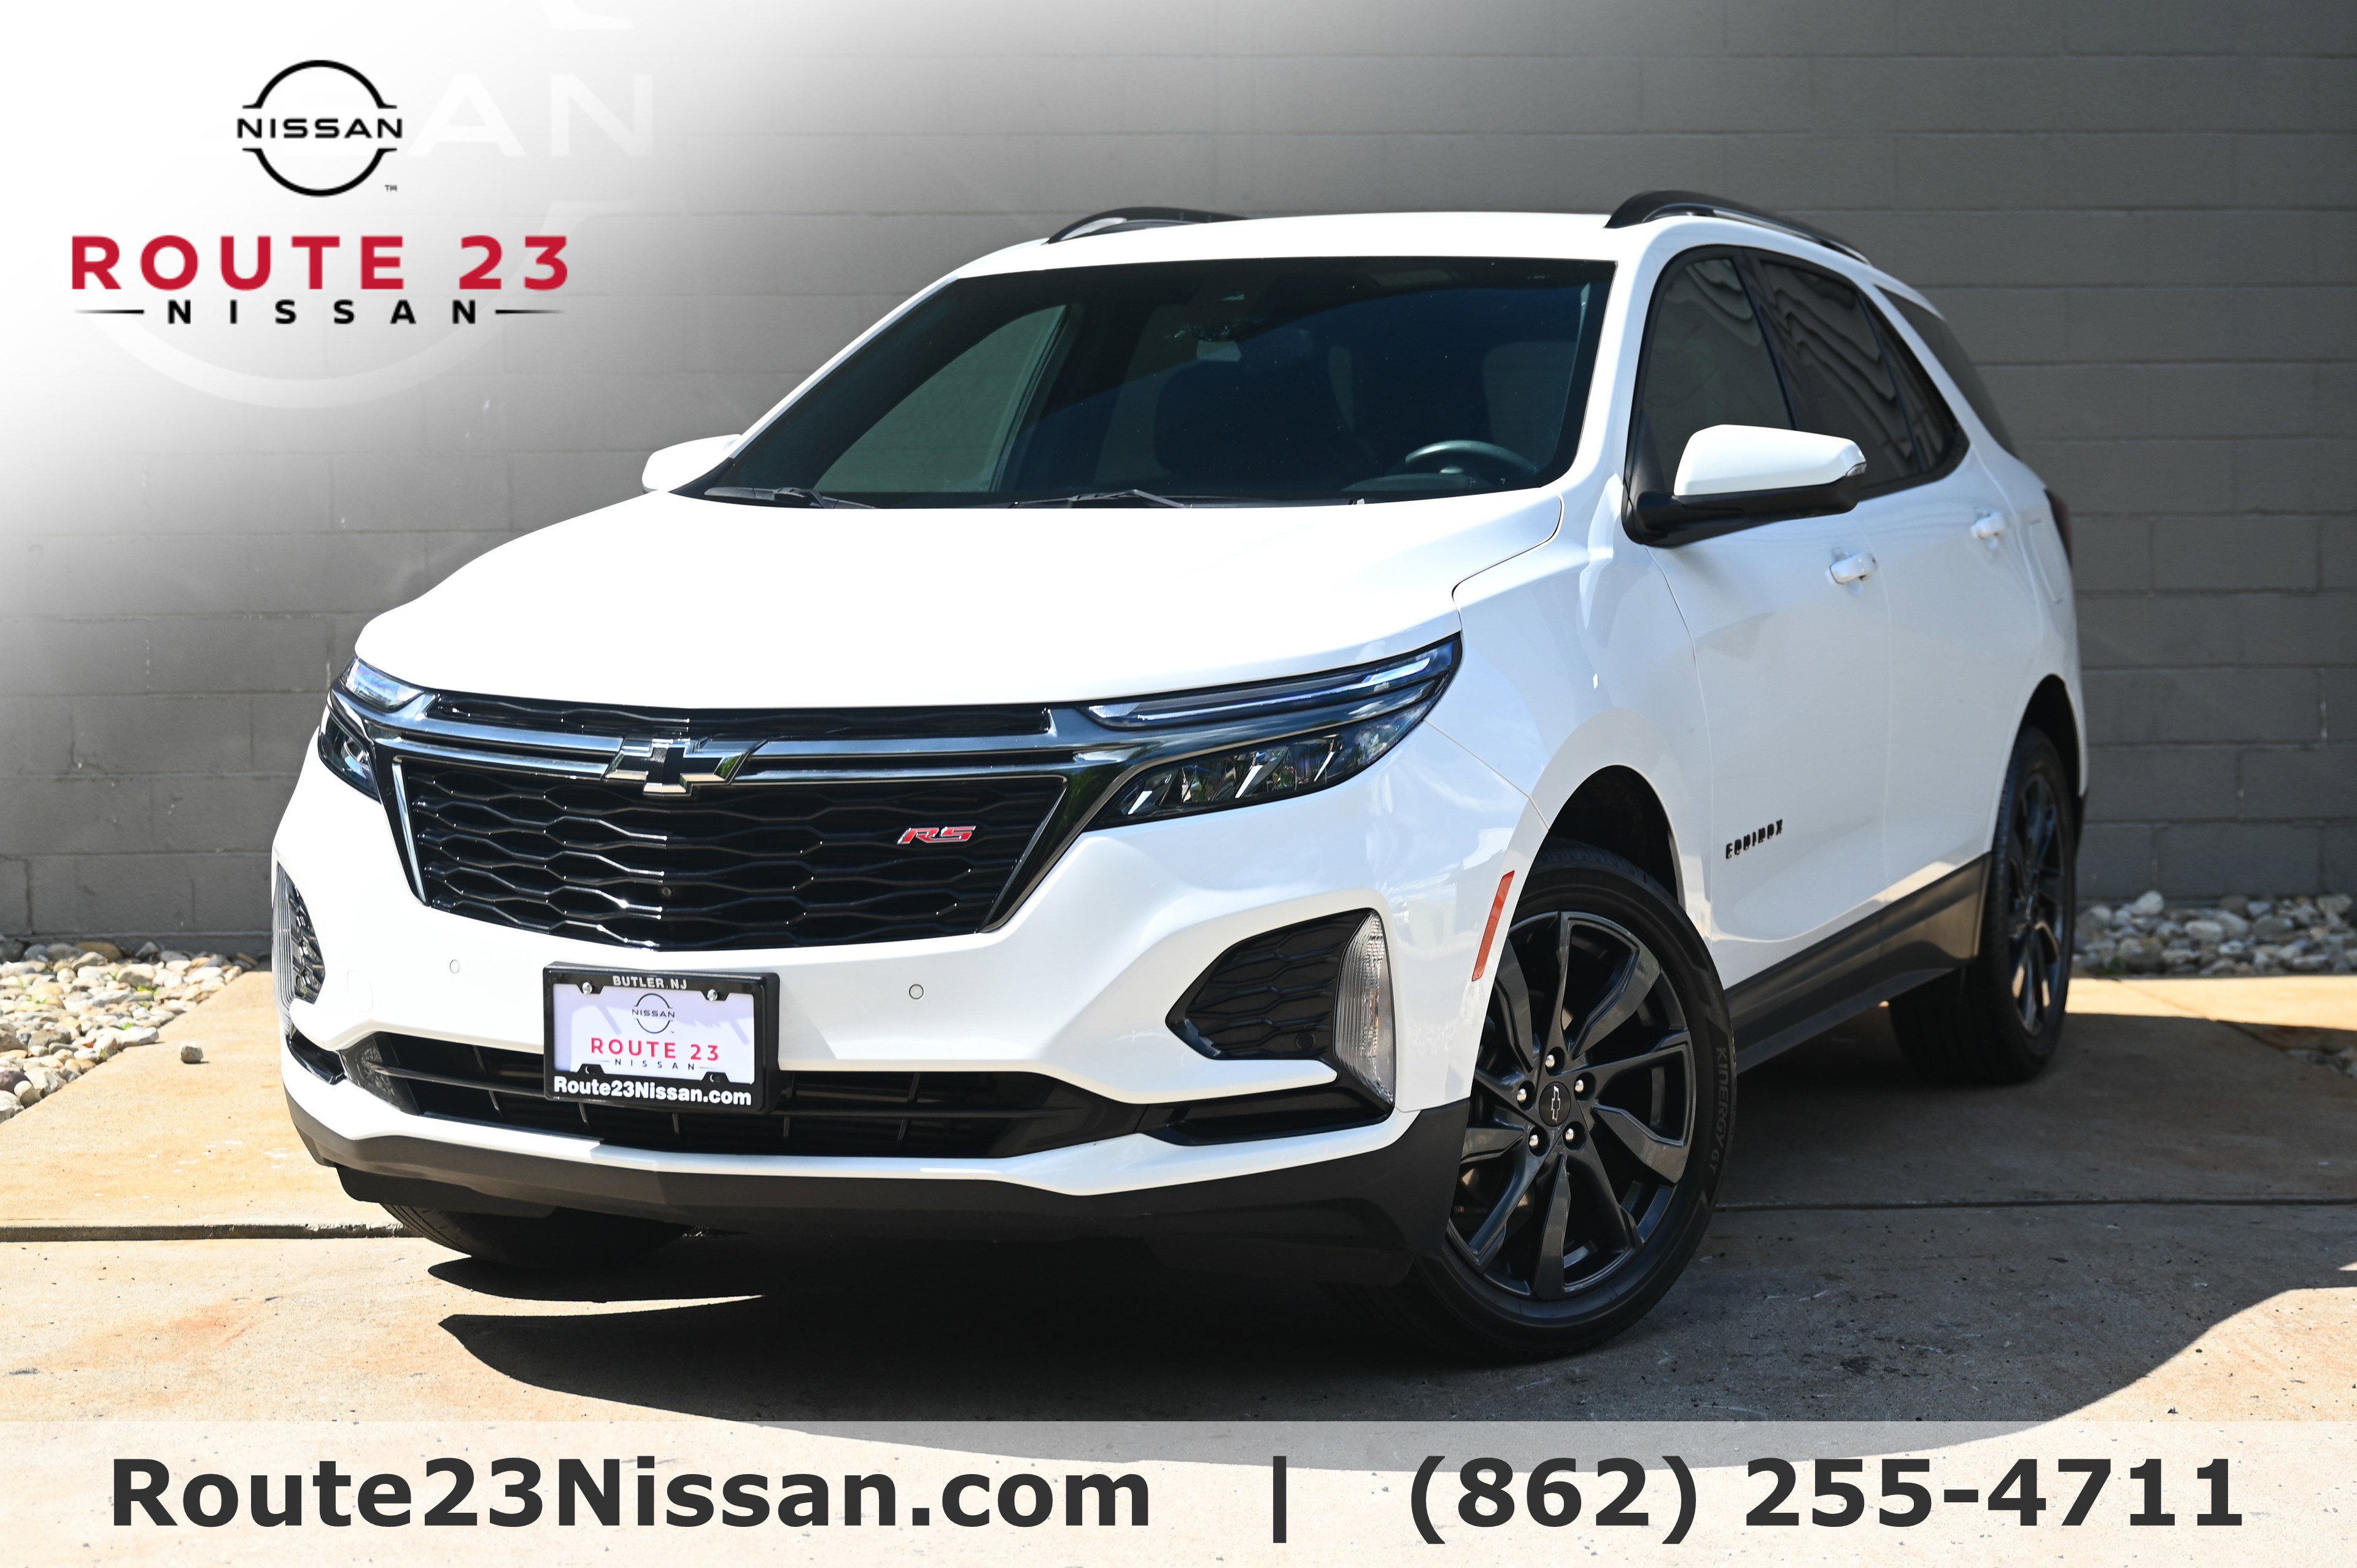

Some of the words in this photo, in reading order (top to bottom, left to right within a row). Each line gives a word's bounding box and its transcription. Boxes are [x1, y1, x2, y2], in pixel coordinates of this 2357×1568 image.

[897, 826, 976, 844] RS
[1725, 819, 1782, 859] EQUINOX
[670, 978, 687, 989] NJ
[632, 1009, 675, 1018] NISSAN
[591, 1037, 676, 1059] ROUTE
[691, 1044, 719, 1061] 23
[615, 1059, 694, 1070] NISSAN
[554, 1076, 752, 1106] Route23Nissan.com
[1715, 1047, 1729, 1149] KINERGY
[1709, 1149, 1720, 1175] GT
